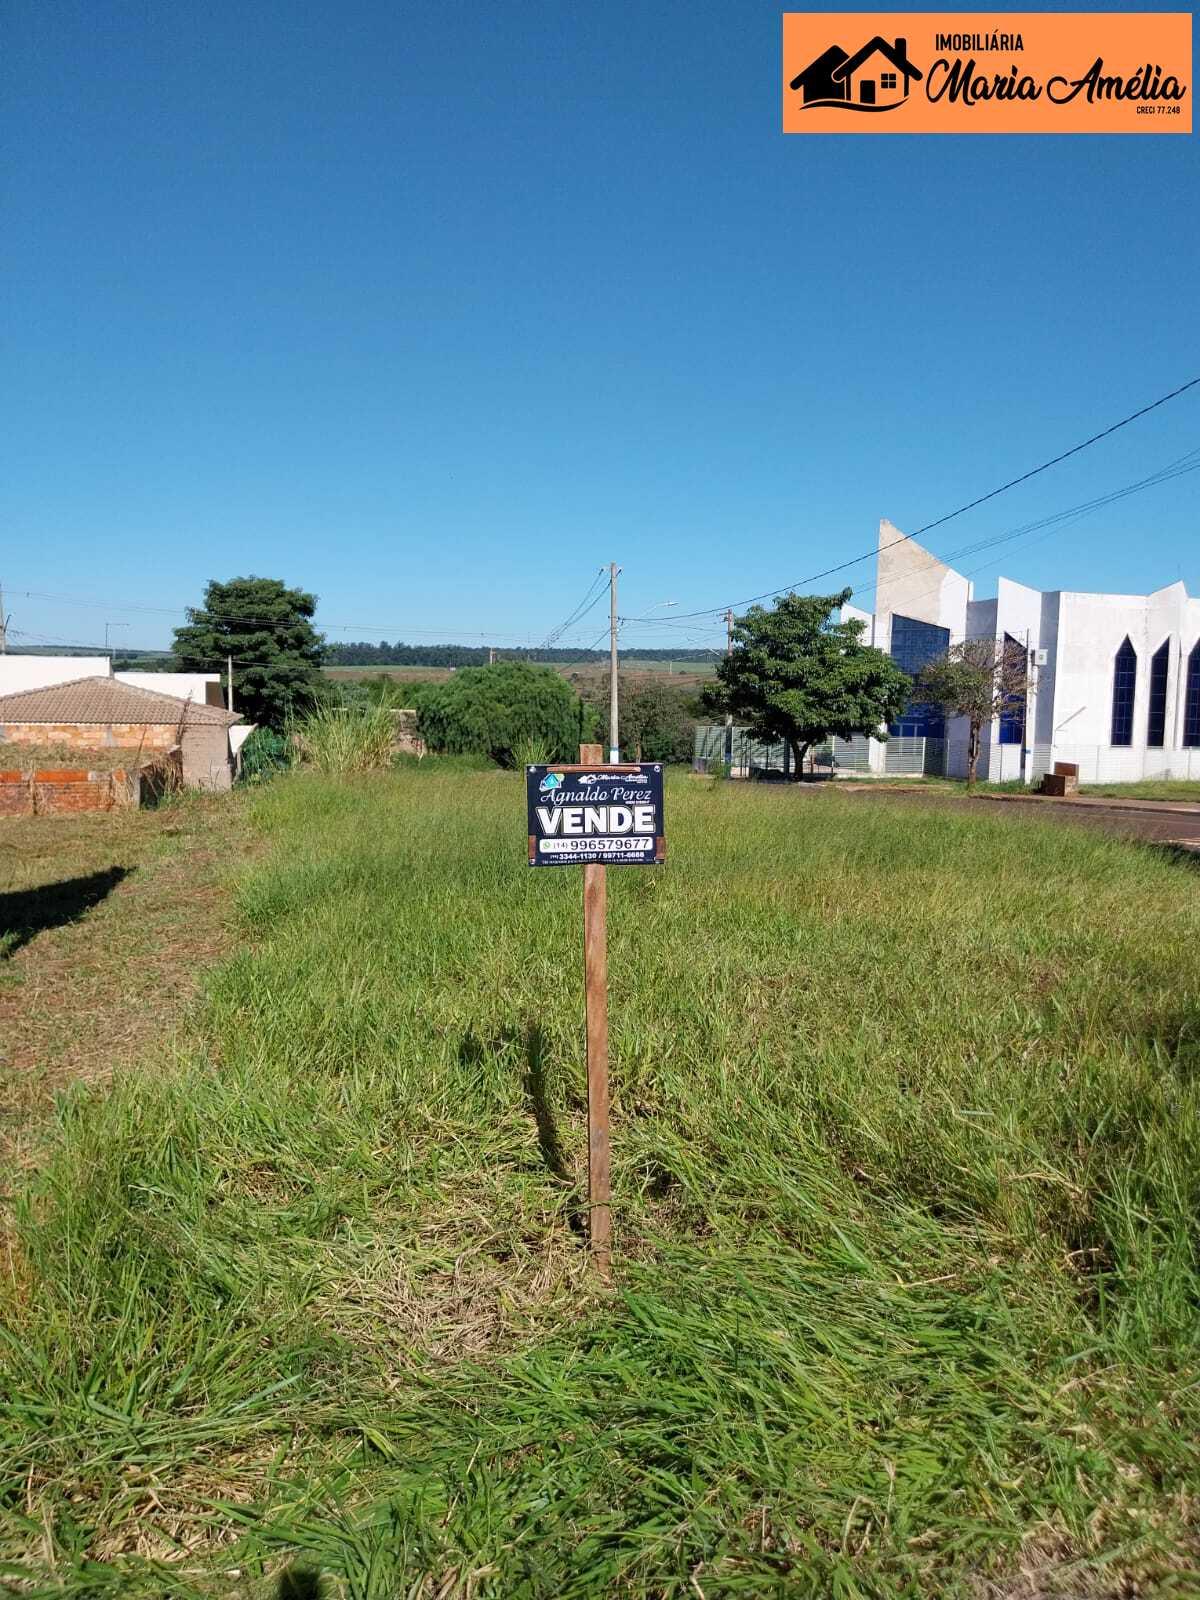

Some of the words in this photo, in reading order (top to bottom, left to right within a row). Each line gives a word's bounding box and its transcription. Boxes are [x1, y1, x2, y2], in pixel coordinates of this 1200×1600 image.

[540, 786, 609, 806] Agnaldo
[610, 787, 652, 801] Perez
[536, 804, 656, 835] VENDE
[570, 839, 649, 851] 996579677
